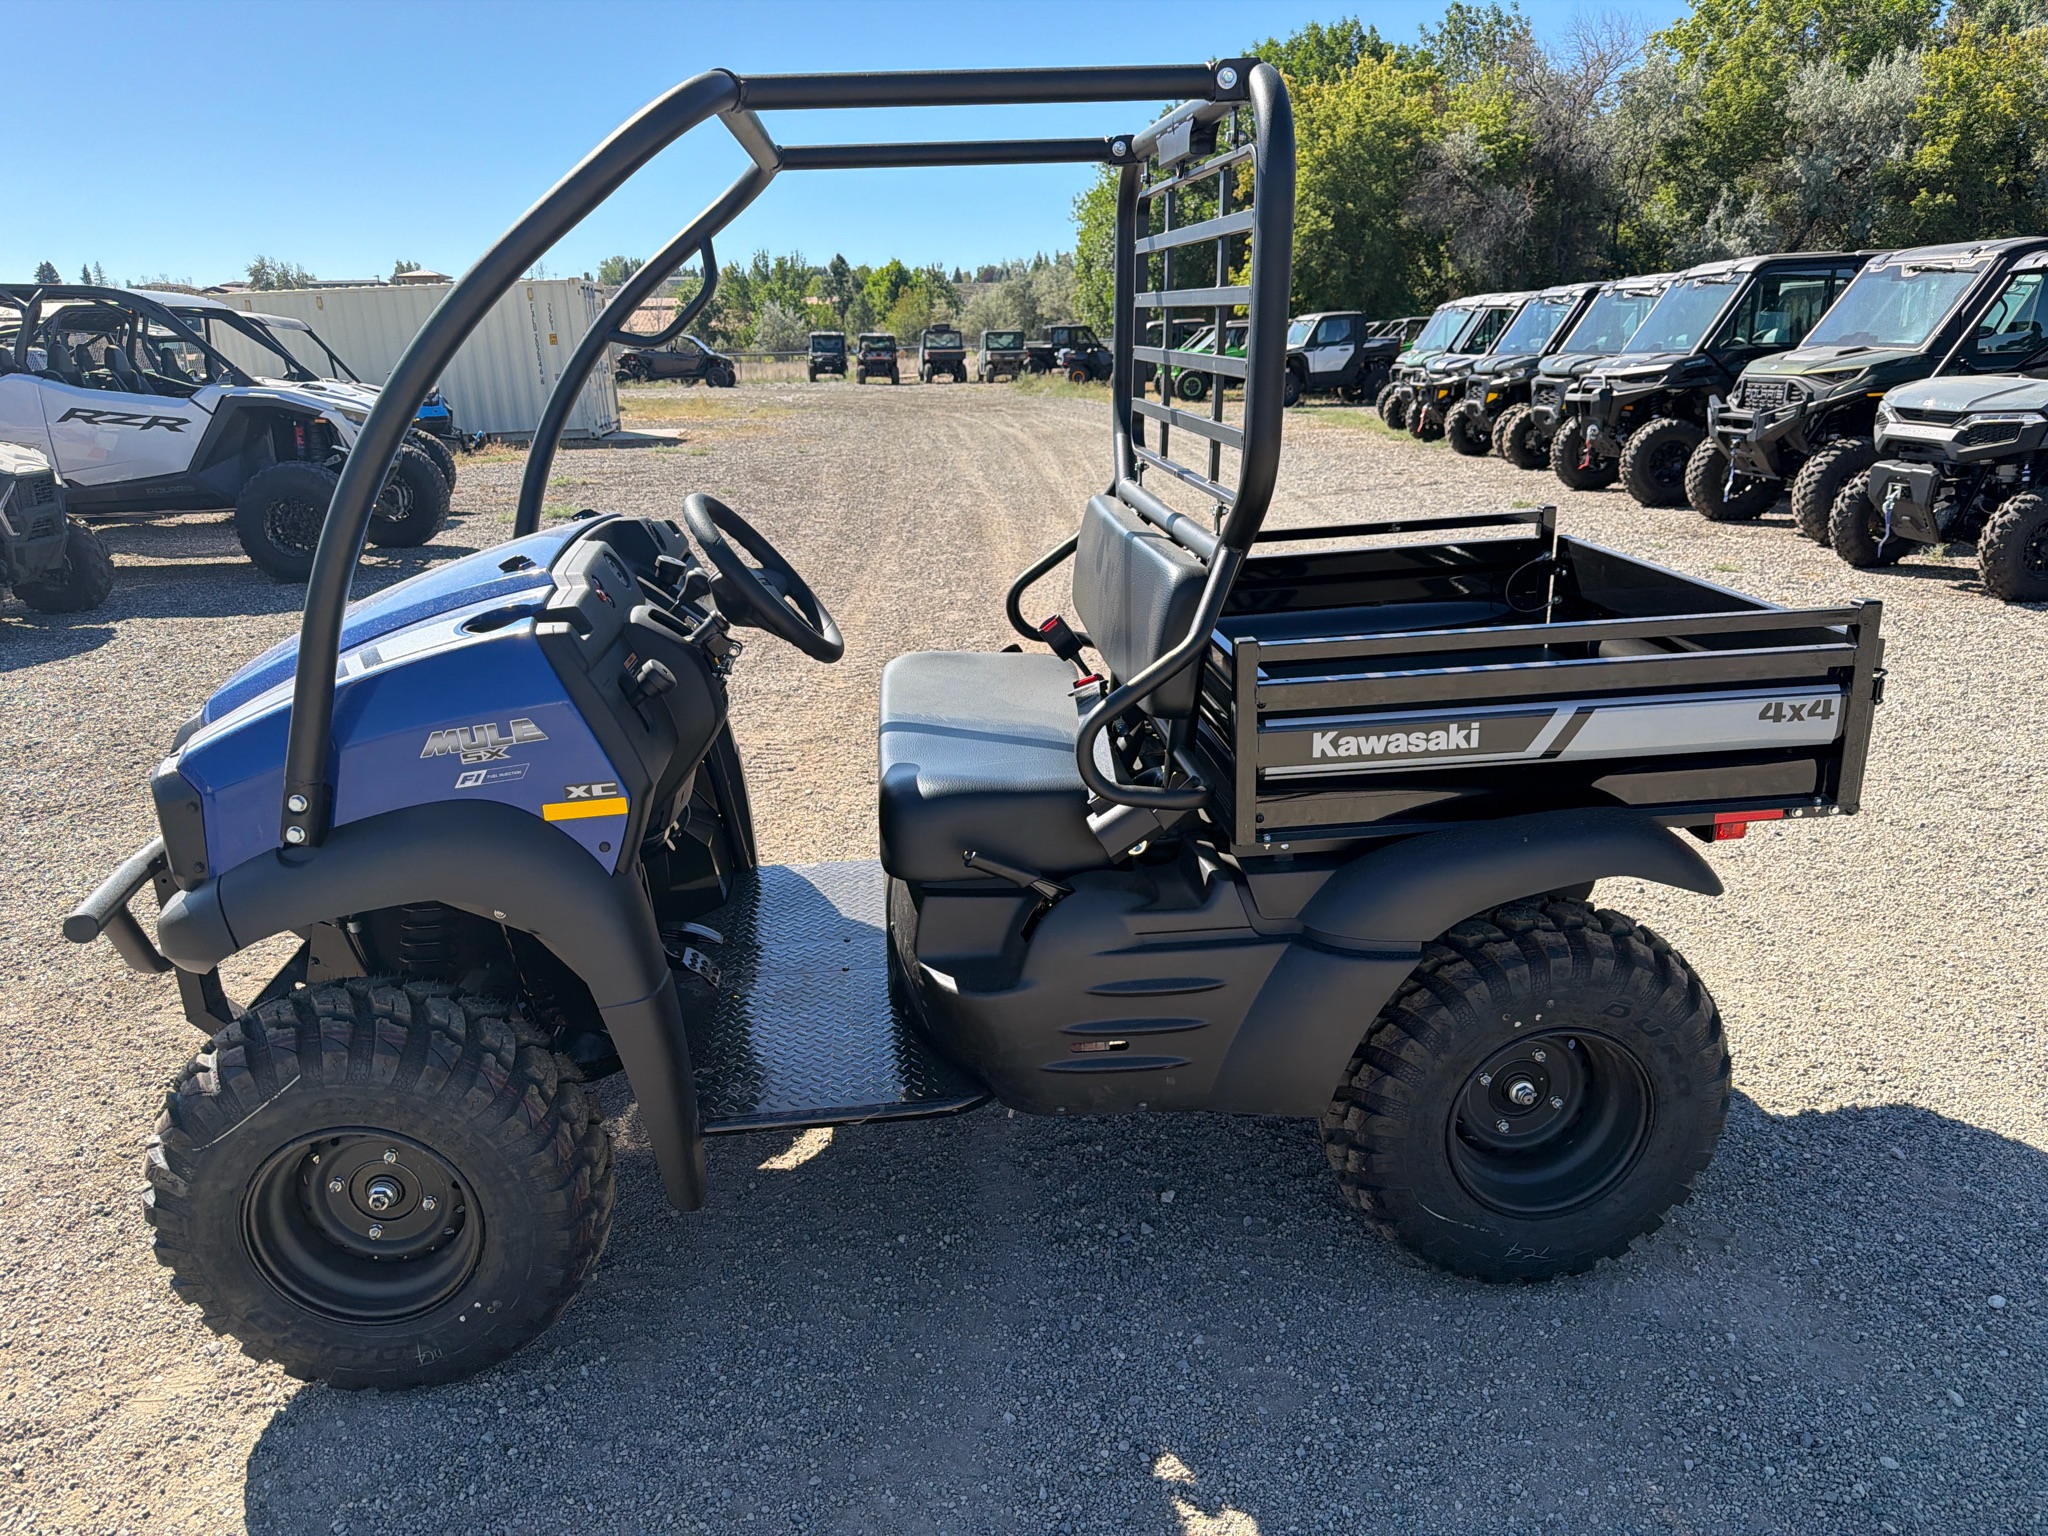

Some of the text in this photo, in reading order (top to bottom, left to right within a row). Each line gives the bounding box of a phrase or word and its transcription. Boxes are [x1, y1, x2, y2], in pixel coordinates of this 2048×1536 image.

[57, 408, 192, 433] RZR
[1758, 699, 1835, 723] 4x4
[420, 718, 549, 759] MULE
[1312, 722, 1480, 758] Kawasaki
[460, 746, 512, 764] SX
[566, 783, 618, 799] XC
